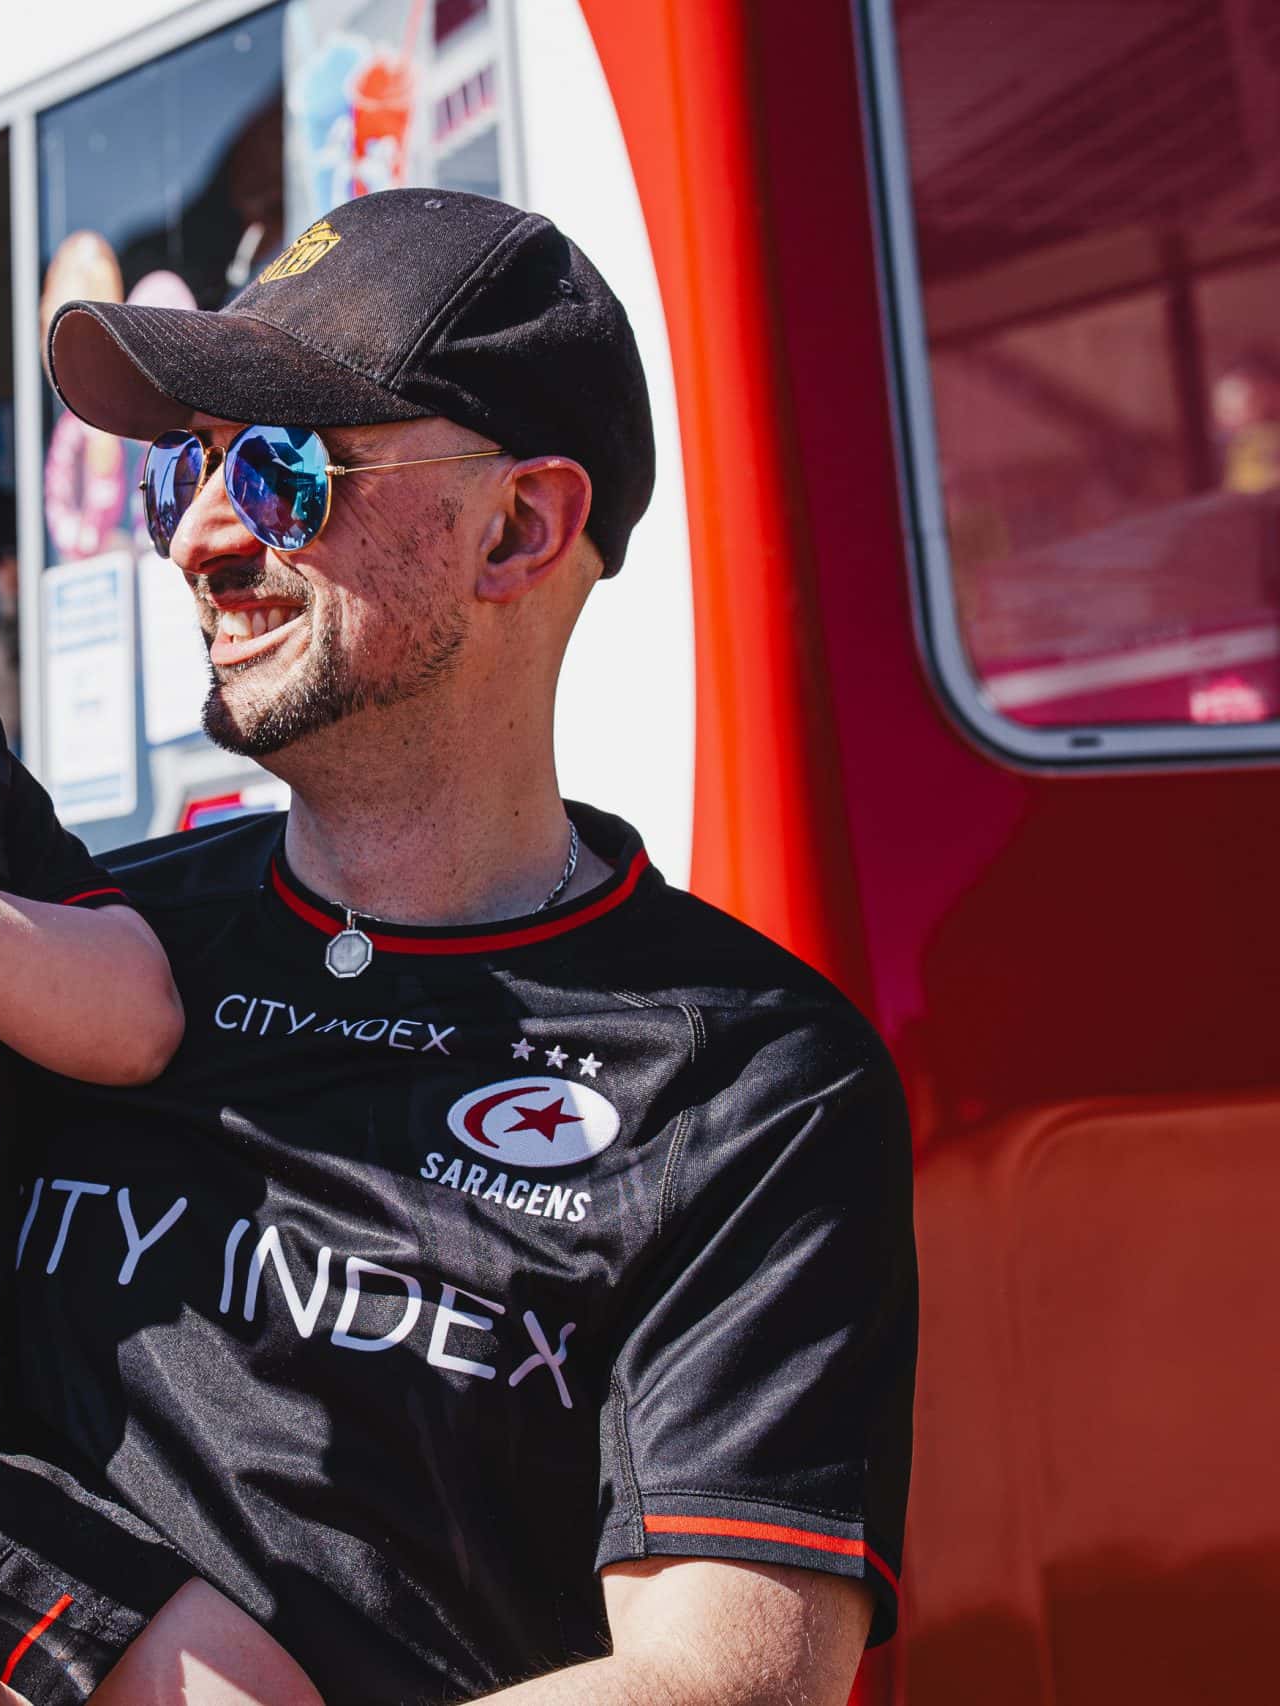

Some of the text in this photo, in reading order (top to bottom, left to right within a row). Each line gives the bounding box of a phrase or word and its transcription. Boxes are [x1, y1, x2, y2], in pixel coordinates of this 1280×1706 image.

[214, 994, 456, 1056] CITY INDEX
[420, 1152, 592, 1222] SARACENS
[16, 1177, 577, 1409] ITY INDEX
